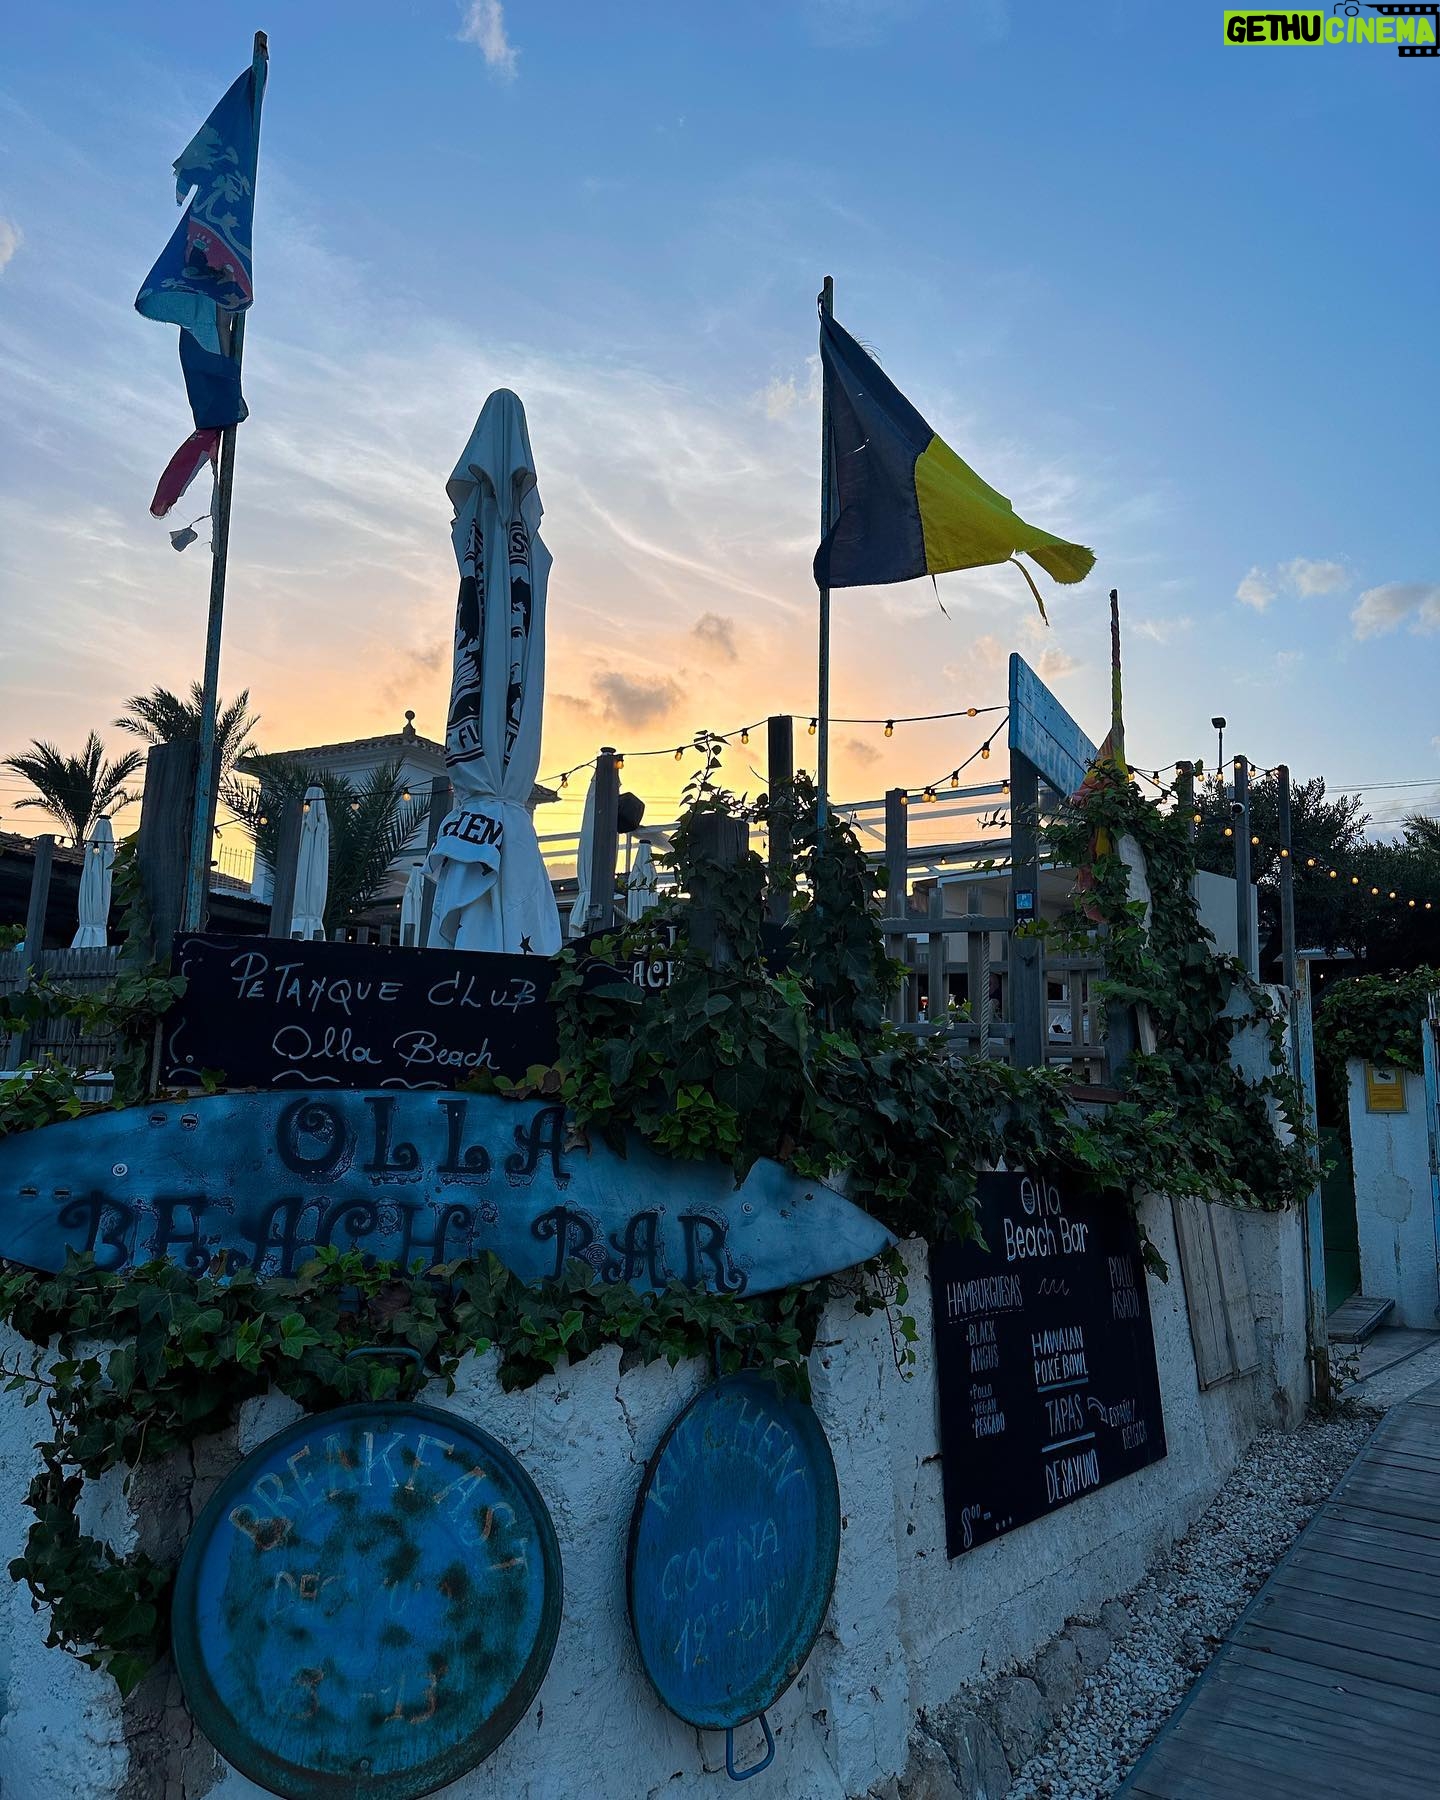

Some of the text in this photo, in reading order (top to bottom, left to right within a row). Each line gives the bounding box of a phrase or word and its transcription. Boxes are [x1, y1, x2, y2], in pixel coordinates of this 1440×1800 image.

[272, 1024, 501, 1071] Olla Beach
[275, 1094, 572, 1181] OLLA
[58, 1188, 748, 1295] BEACH BAR
[1003, 1216, 1089, 1262] Beach Bar
[946, 1273, 1023, 1318] HAMBURGUESAS
[968, 1320, 997, 1347] BLACK
[1031, 1325, 1084, 1357] HAWAIAN
[970, 1343, 1000, 1374] ANGUS
[1062, 1351, 1088, 1379] BOWL
[974, 1411, 1006, 1439] PESCADO
[1045, 1393, 1084, 1438] TAPAS
[1045, 1448, 1100, 1504] DESAYUNO
